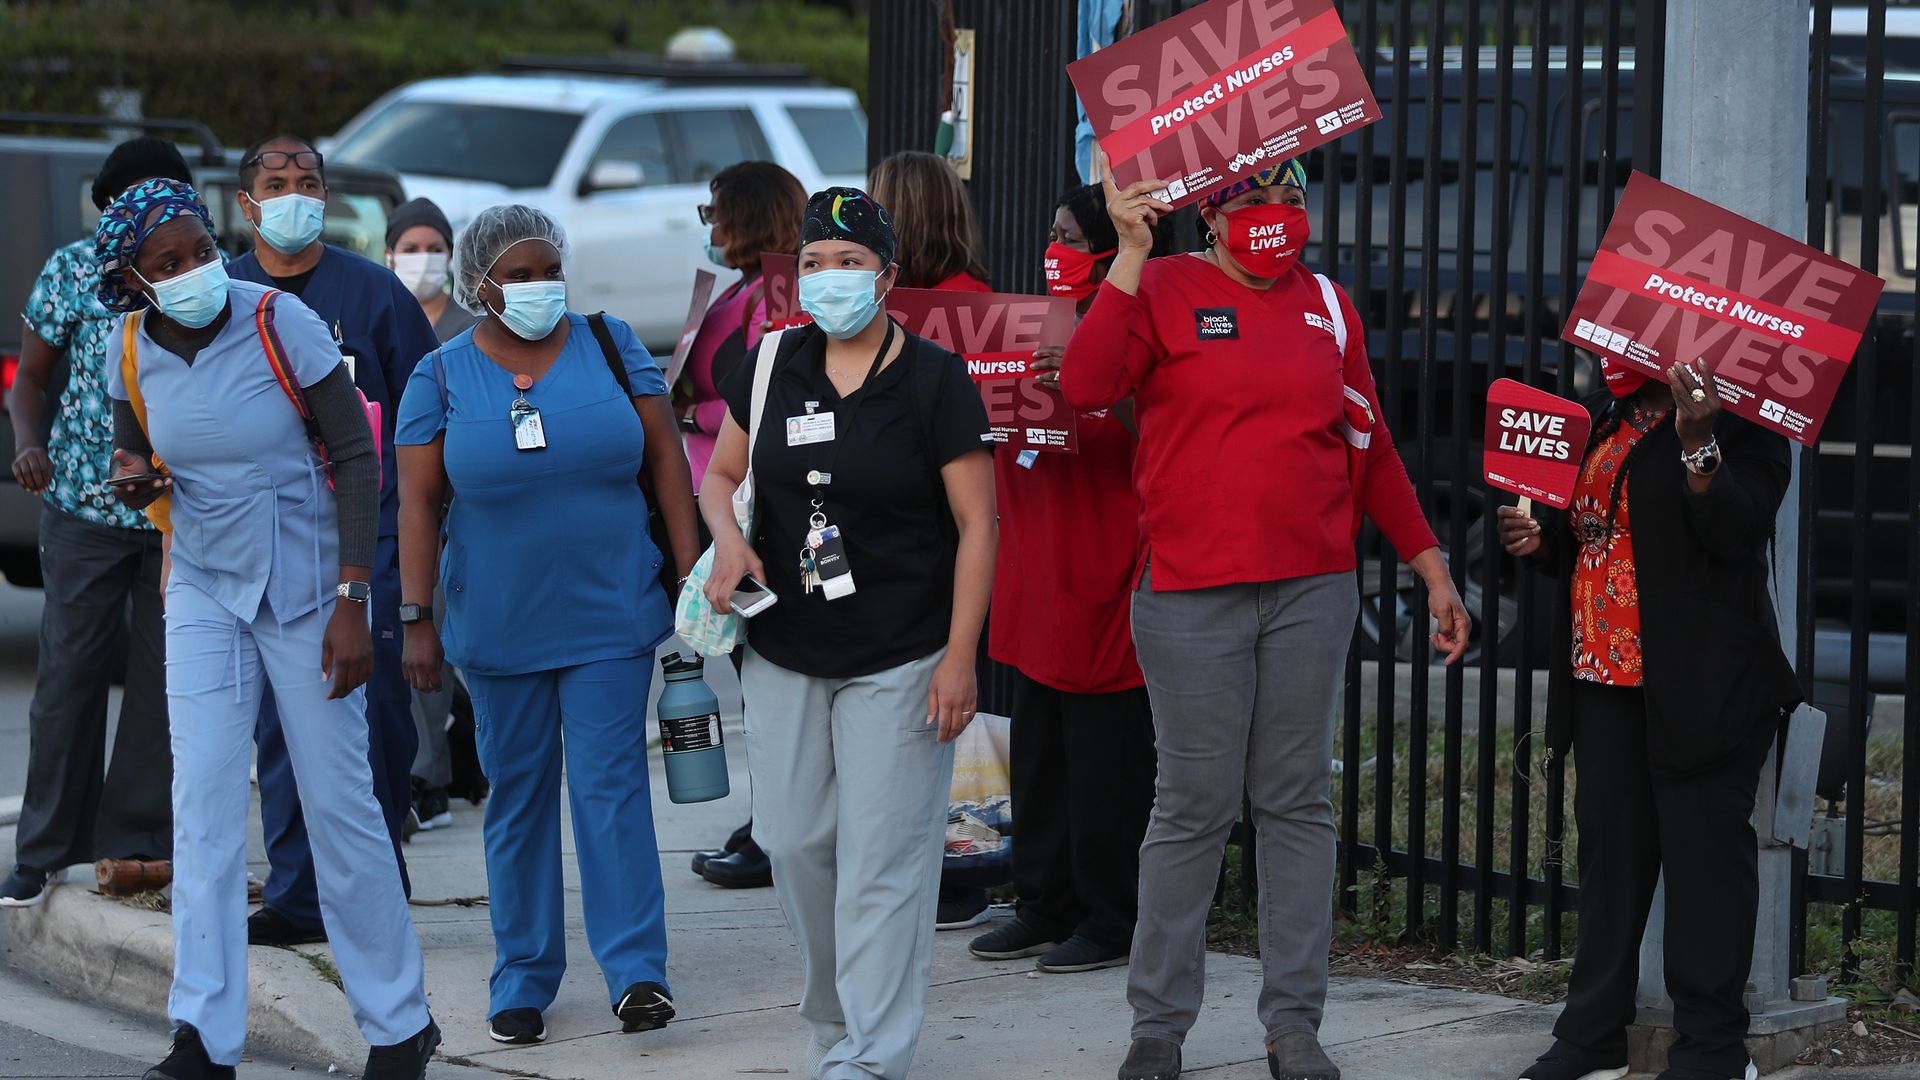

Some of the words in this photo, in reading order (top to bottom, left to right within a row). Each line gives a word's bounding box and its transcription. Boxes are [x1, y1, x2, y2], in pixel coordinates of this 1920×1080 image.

[1150, 82, 1224, 135] Protect
[1225, 45, 1294, 93] Nurses
[1338, 98, 1365, 113] National
[1341, 107, 1363, 119] Nurses
[1343, 112, 1365, 125] United
[1262, 132, 1288, 147] National
[1287, 124, 1308, 137] Nurses
[1265, 136, 1298, 152] Organizing
[1267, 141, 1300, 158] Committee
[1184, 166, 1213, 182] California
[1186, 175, 1207, 188] Nurses
[1189, 175, 1223, 193] Association
[1248, 223, 1285, 238] SAVE
[1250, 234, 1287, 250] LIVES
[1616, 209, 1856, 320] SAVE
[1643, 273, 1729, 313] Protect
[1729, 301, 1805, 339] Nurses
[1203, 315, 1229, 327] black
[1593, 287, 1829, 398] LIVES
[1630, 340, 1660, 358] California
[1627, 346, 1649, 359] Nurses
[967, 360, 1026, 375] Nurses
[1625, 352, 1661, 371] Association
[1735, 385, 1756, 399] Nurses
[1499, 408, 1566, 436] SAVE
[1784, 414, 1805, 428] Nurses
[1786, 408, 1813, 425] National
[1781, 419, 1803, 433] United
[1499, 431, 1570, 460] LIVES
